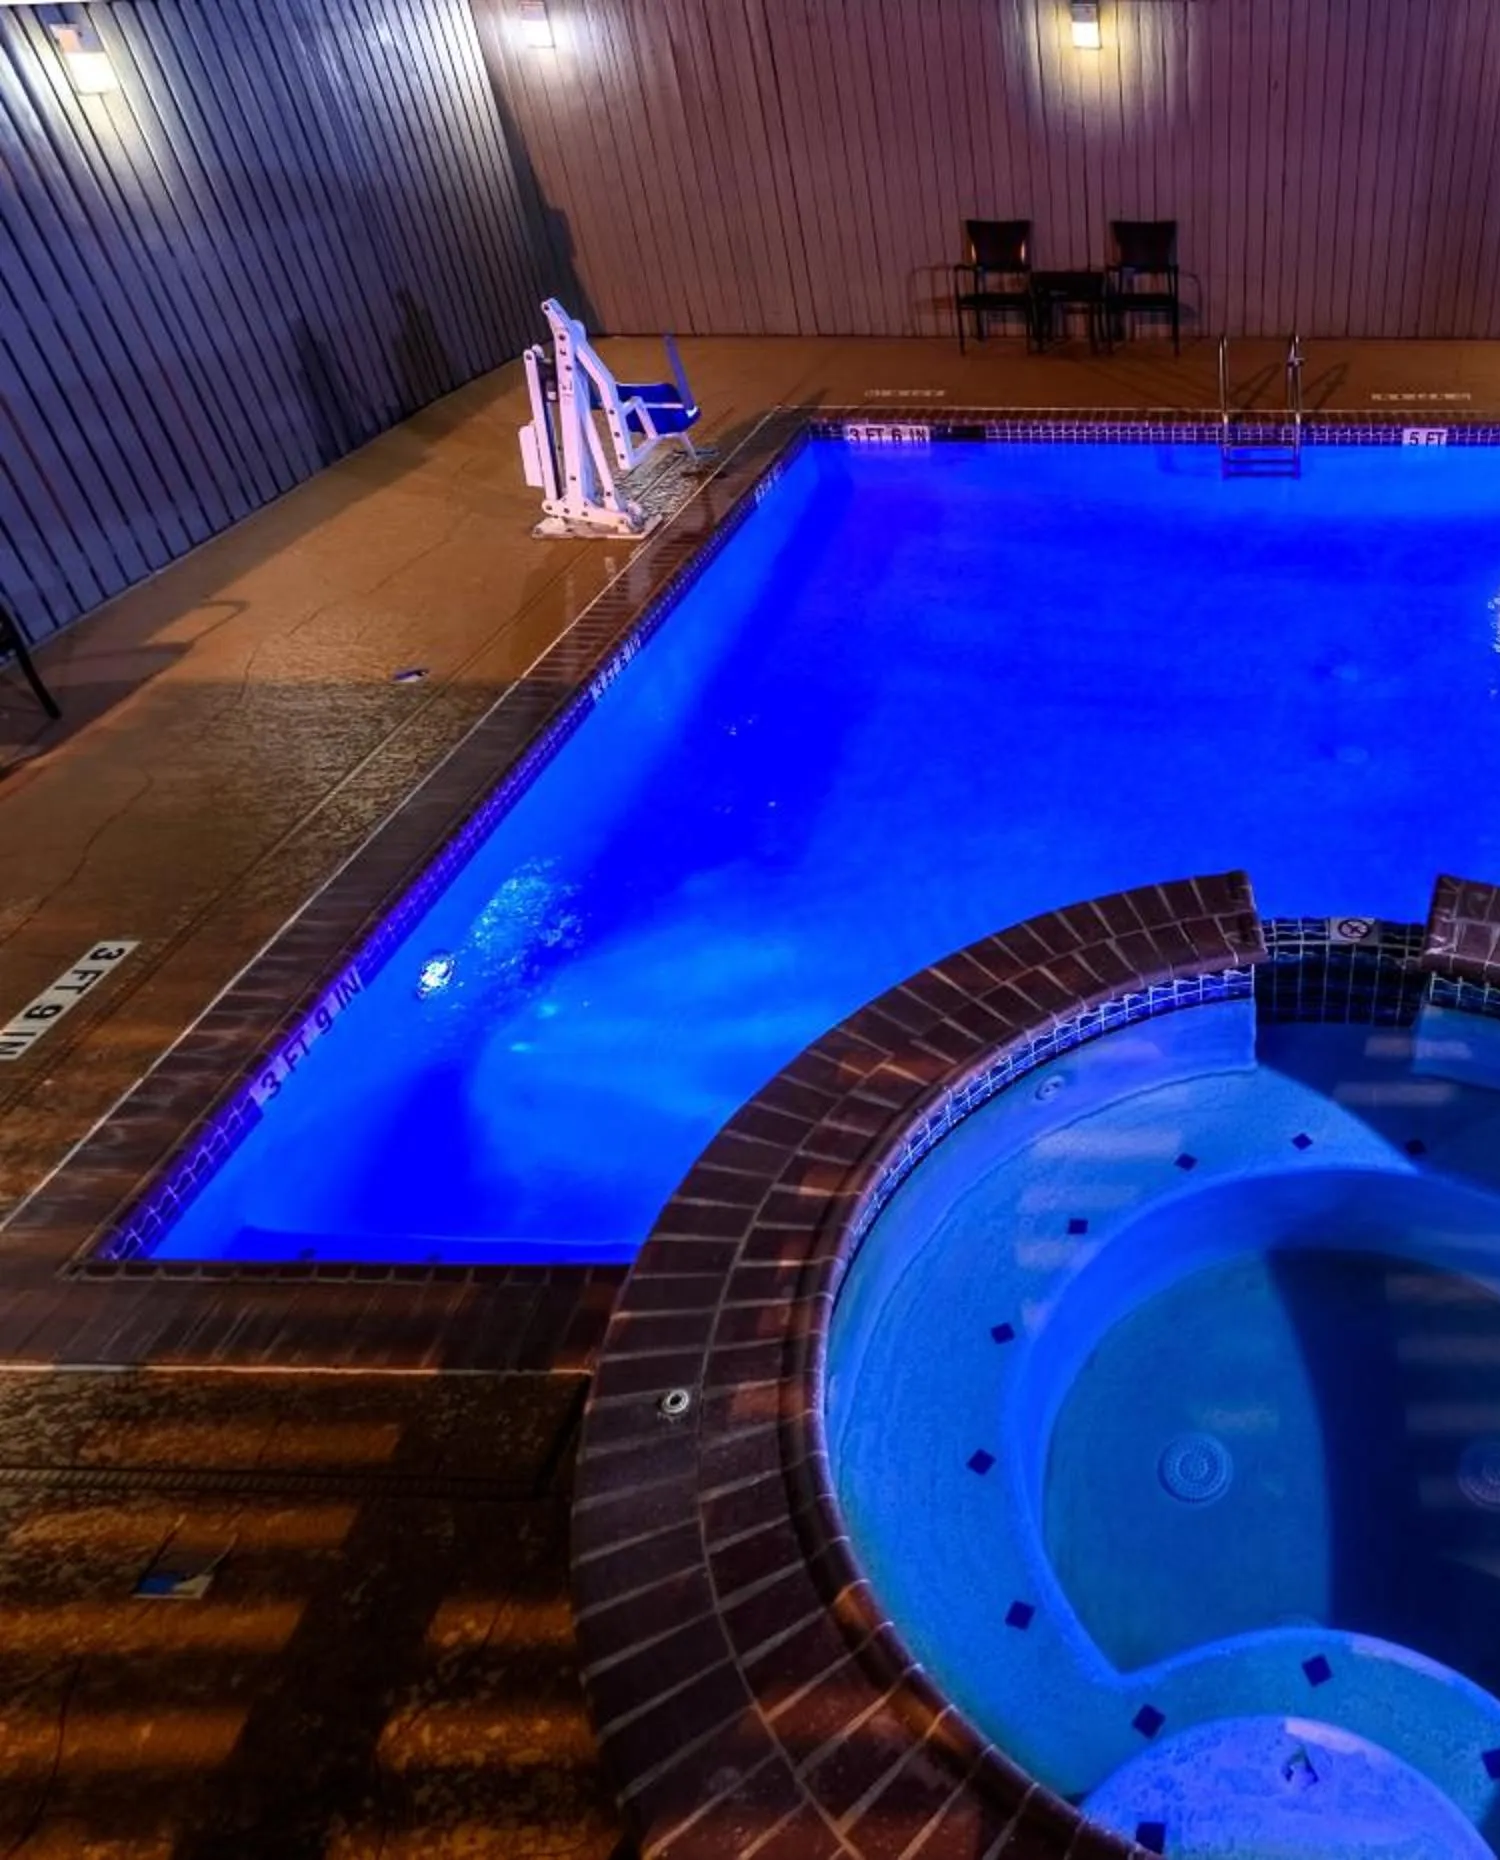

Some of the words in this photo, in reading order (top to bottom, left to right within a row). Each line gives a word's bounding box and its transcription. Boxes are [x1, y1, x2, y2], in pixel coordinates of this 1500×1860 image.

[849, 427, 861, 443] 3
[865, 427, 885, 444] FT
[908, 427, 927, 444] IN
[1409, 431, 1421, 446] 5
[1426, 431, 1445, 446] FT
[90, 947, 125, 960] 3
[54, 969, 104, 995] FT
[23, 1004, 64, 1019] 9
[0, 1031, 37, 1055] IN
[260, 1071, 282, 1100] 3
[283, 1030, 310, 1073] FT
[314, 1006, 334, 1035] 9
[335, 973, 362, 1011] IN
